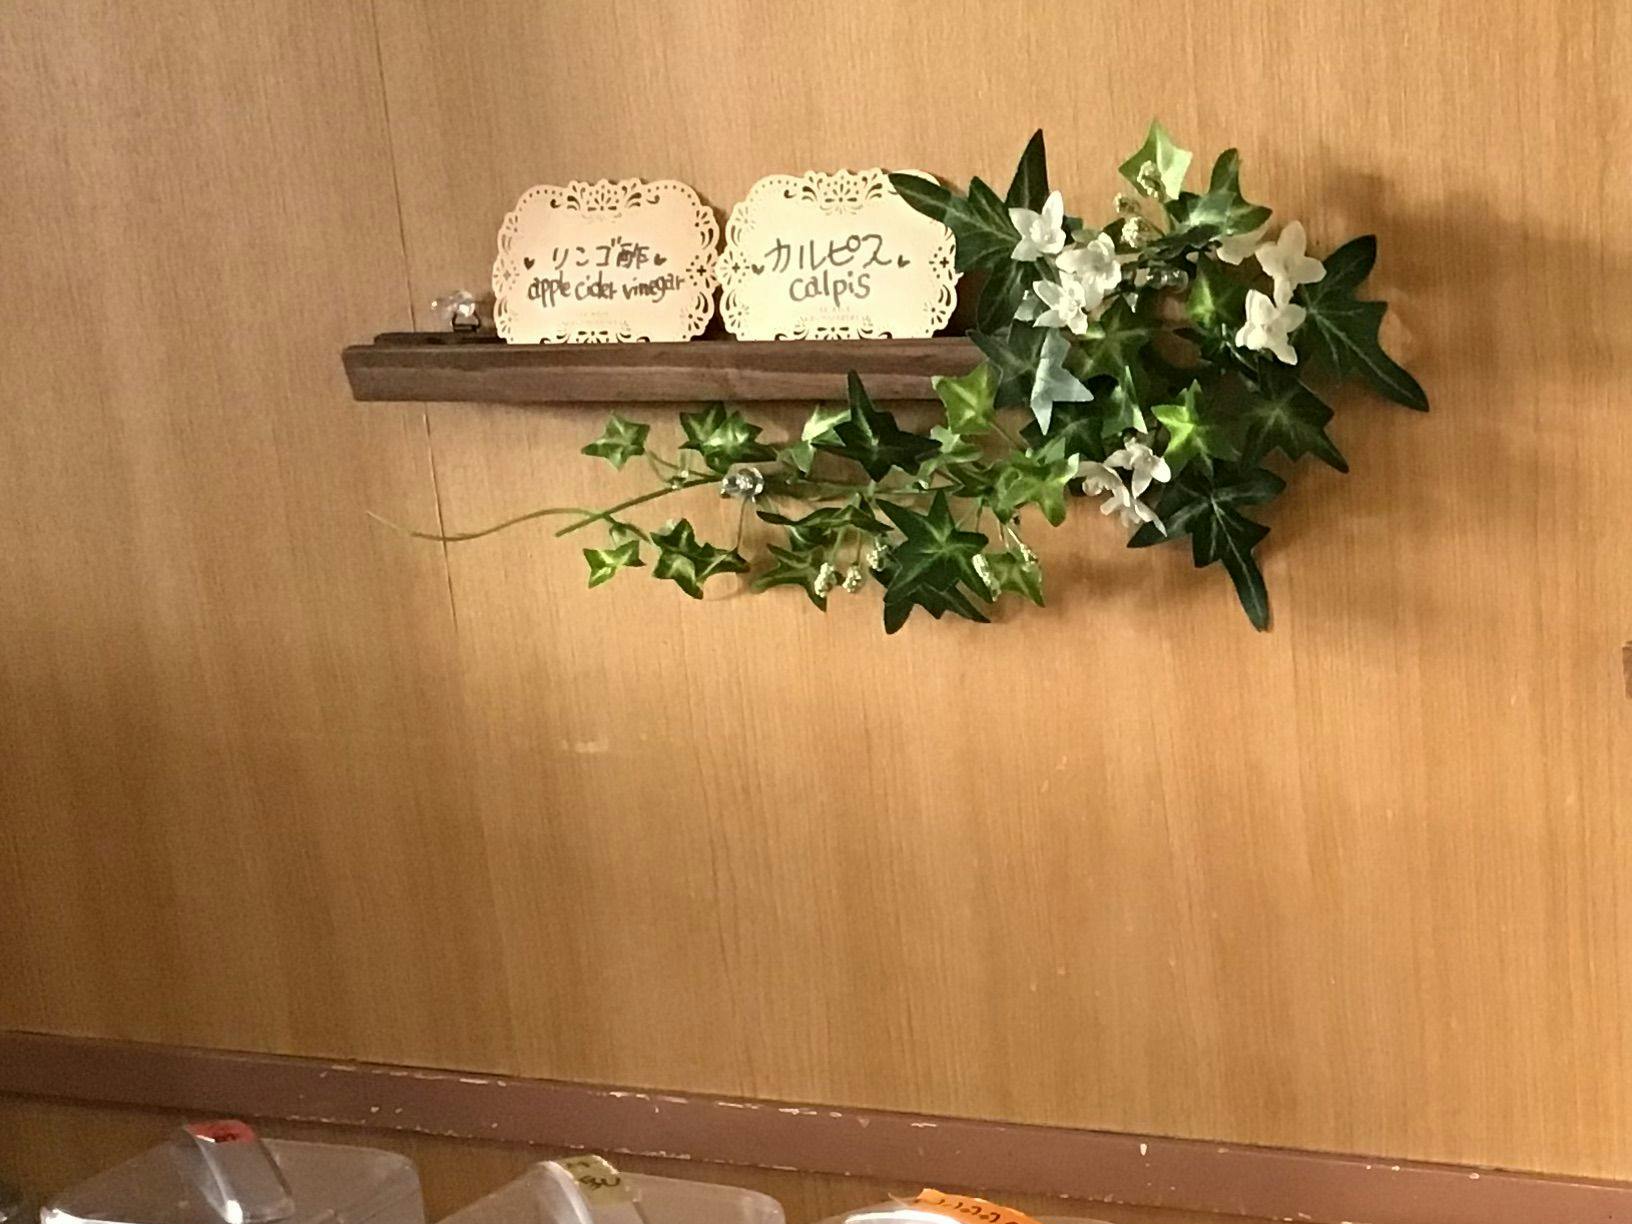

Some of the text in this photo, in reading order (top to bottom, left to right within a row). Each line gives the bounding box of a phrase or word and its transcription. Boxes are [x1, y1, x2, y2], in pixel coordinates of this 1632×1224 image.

[552, 235, 651, 271] リンゴ酢
[764, 233, 892, 274] カルピス
[527, 270, 571, 308] apple
[621, 273, 686, 304] vinegar
